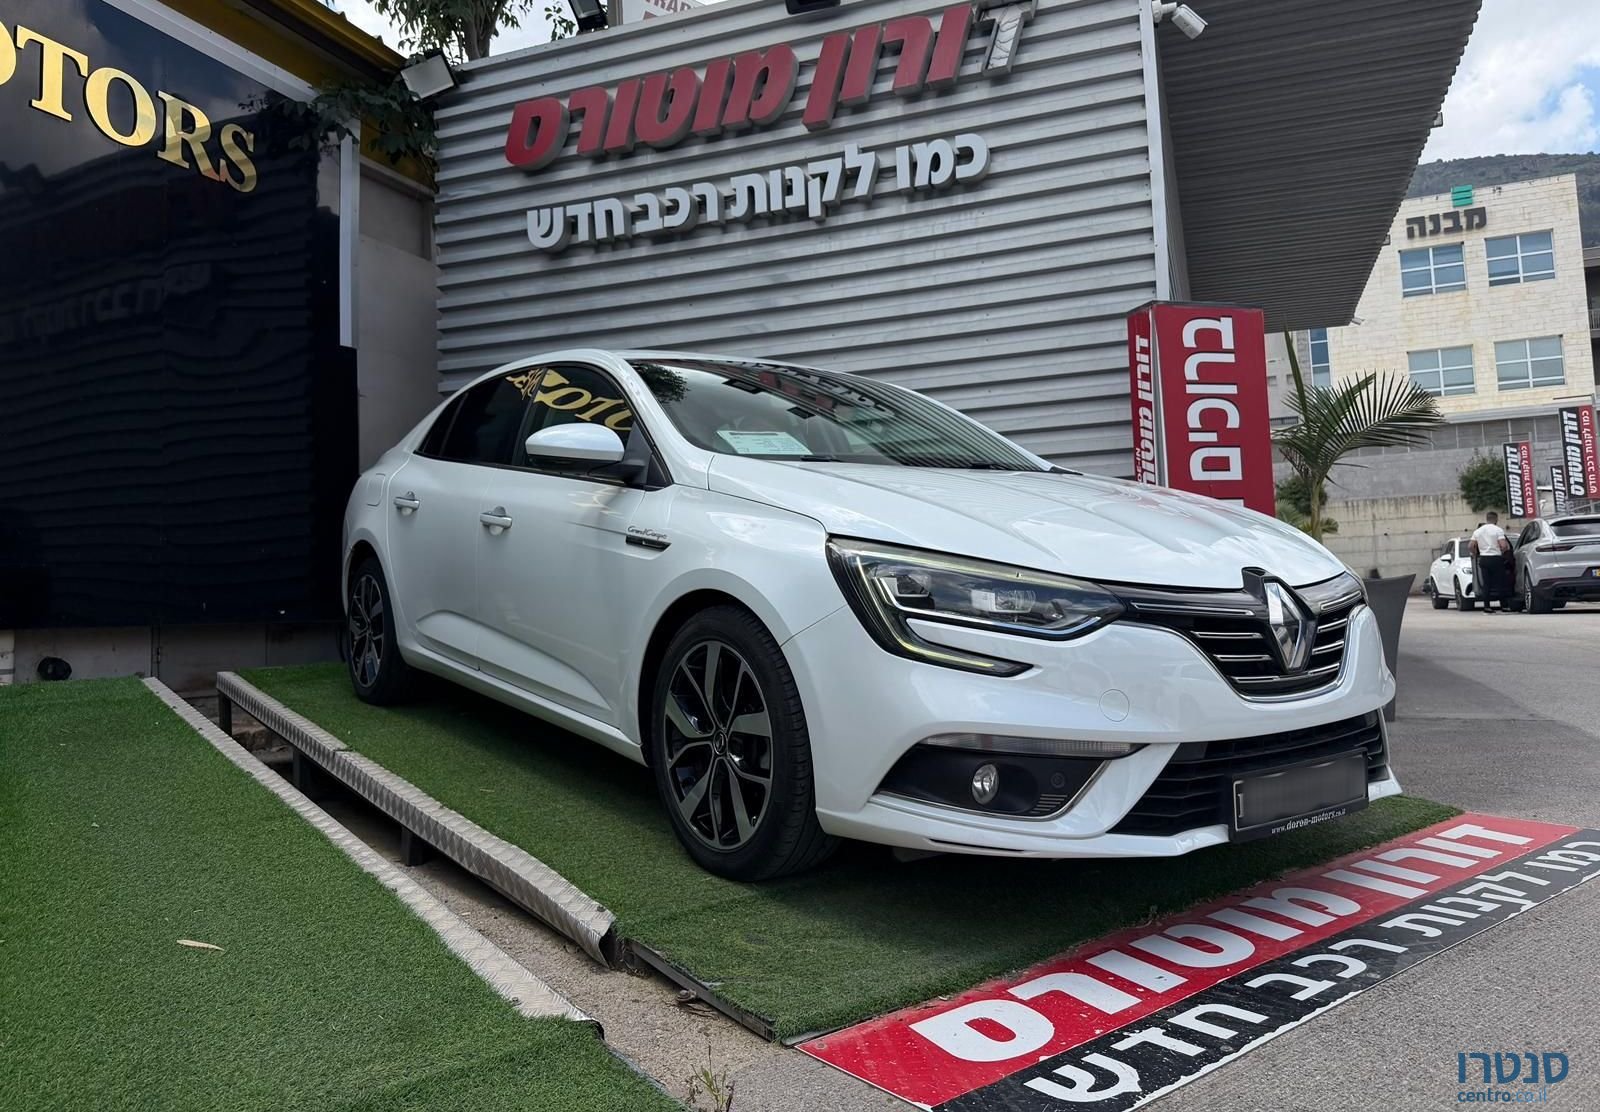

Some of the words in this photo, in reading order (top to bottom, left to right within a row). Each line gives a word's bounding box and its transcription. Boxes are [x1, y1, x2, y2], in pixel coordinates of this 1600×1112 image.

[802, 0, 1038, 131] דורון
[0, 19, 257, 193] TORS
[504, 43, 801, 171] מוטורס
[728, 143, 879, 222] לקנות
[895, 132, 991, 191] כמו
[525, 196, 632, 253] חדש
[632, 181, 724, 235] רכב
[1405, 206, 1487, 240] מבנה
[1136, 335, 1152, 401] דורון
[1181, 316, 1243, 481] ברוכים
[1139, 407, 1157, 485] מוטור
[1506, 446, 1521, 475] דורון
[1563, 411, 1582, 445] דורון
[1508, 473, 1524, 516] מוטורס
[1566, 444, 1585, 496] מוטורס
[1271, 808, 1346, 835] www.doron-motors.co.il
[1320, 823, 1535, 899] דורון
[1377, 870, 1551, 938] לקנות
[908, 887, 1361, 1062] מוטורס
[1244, 938, 1409, 1001] רכב
[1023, 1003, 1270, 1102] חדש
